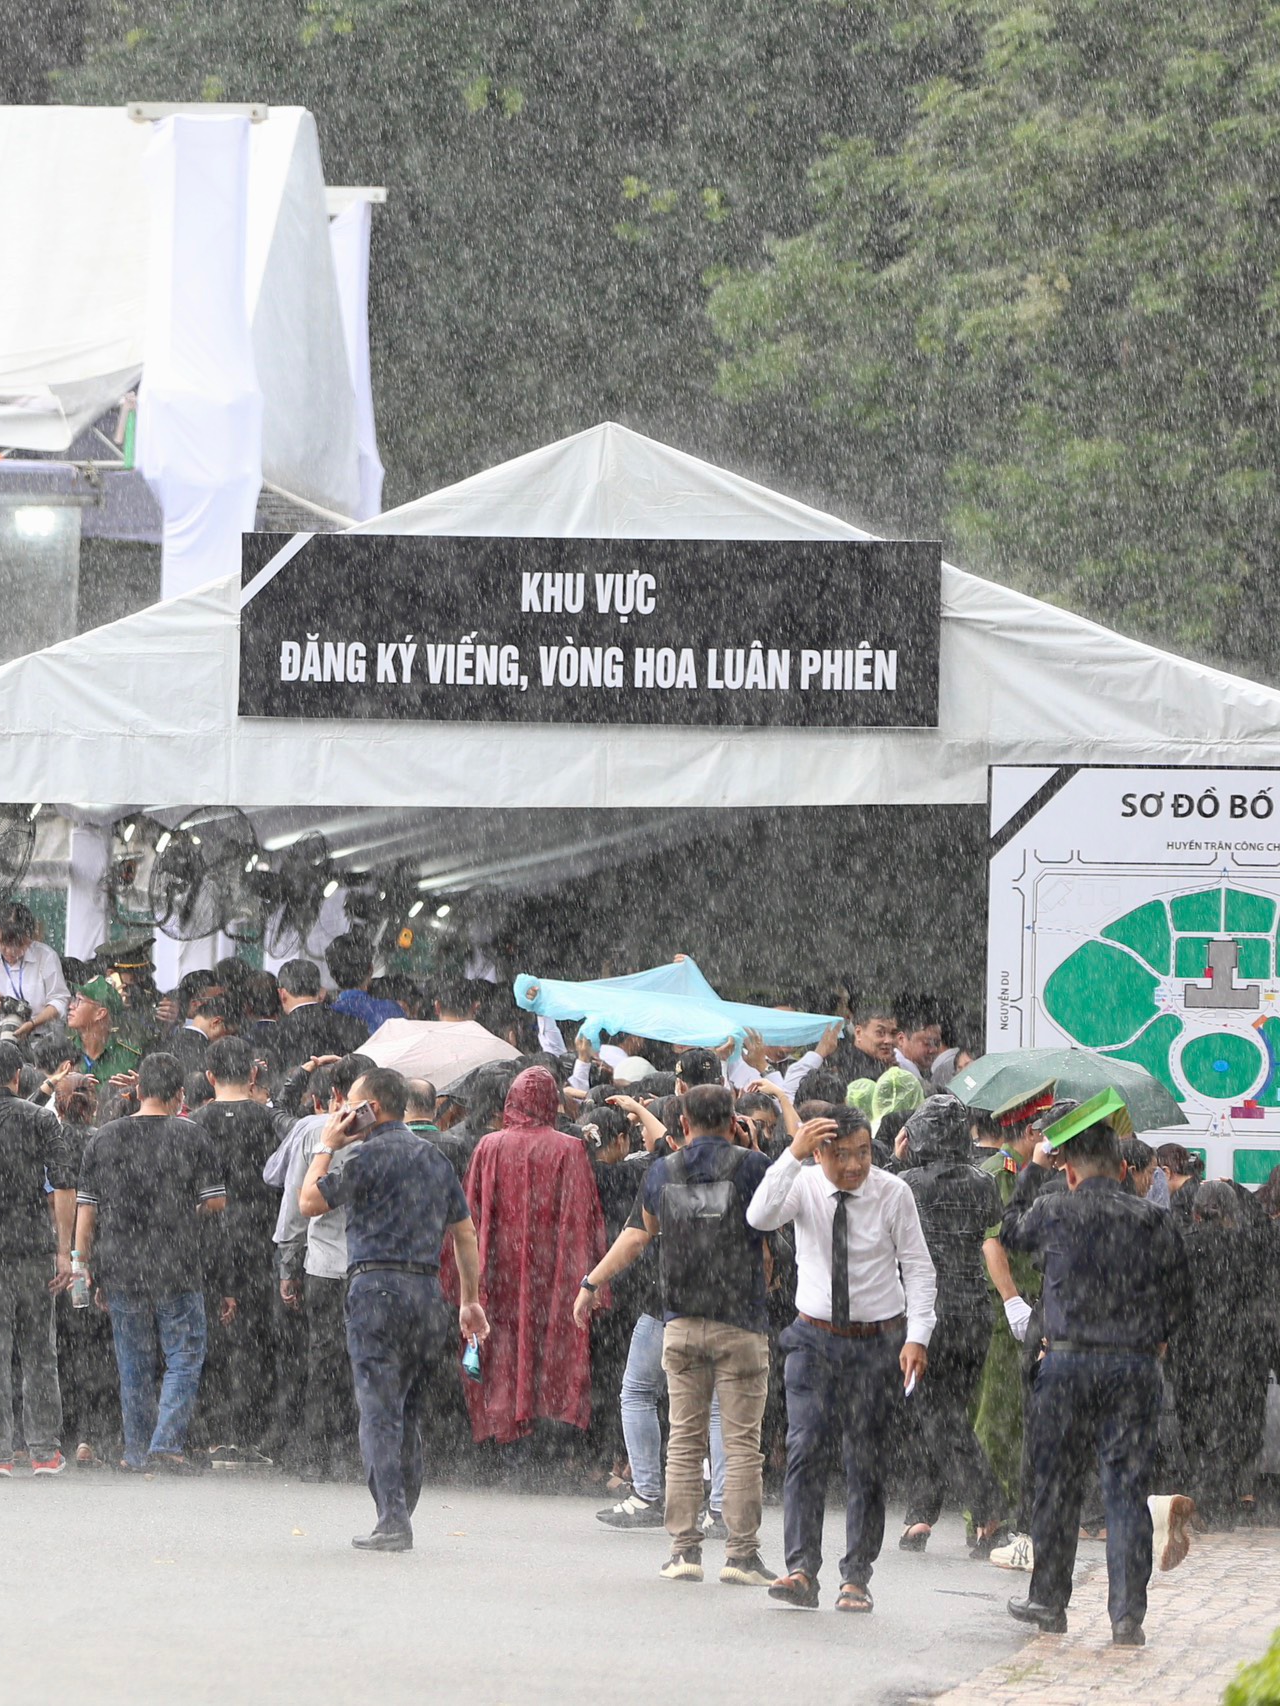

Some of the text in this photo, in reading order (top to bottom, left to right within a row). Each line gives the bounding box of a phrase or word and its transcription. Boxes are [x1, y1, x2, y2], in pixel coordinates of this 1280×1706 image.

[521, 569, 657, 623] KHU VỰC
[280, 631, 898, 691] ĐĂNG KÝ VIẾNG, VÒNG HOA LUÂN PHIÊN
[1120, 786, 1275, 820] SƠ ĐỒ BỐ
[1234, 840, 1265, 852] CÔNG
[1000, 970, 1010, 986] DU
